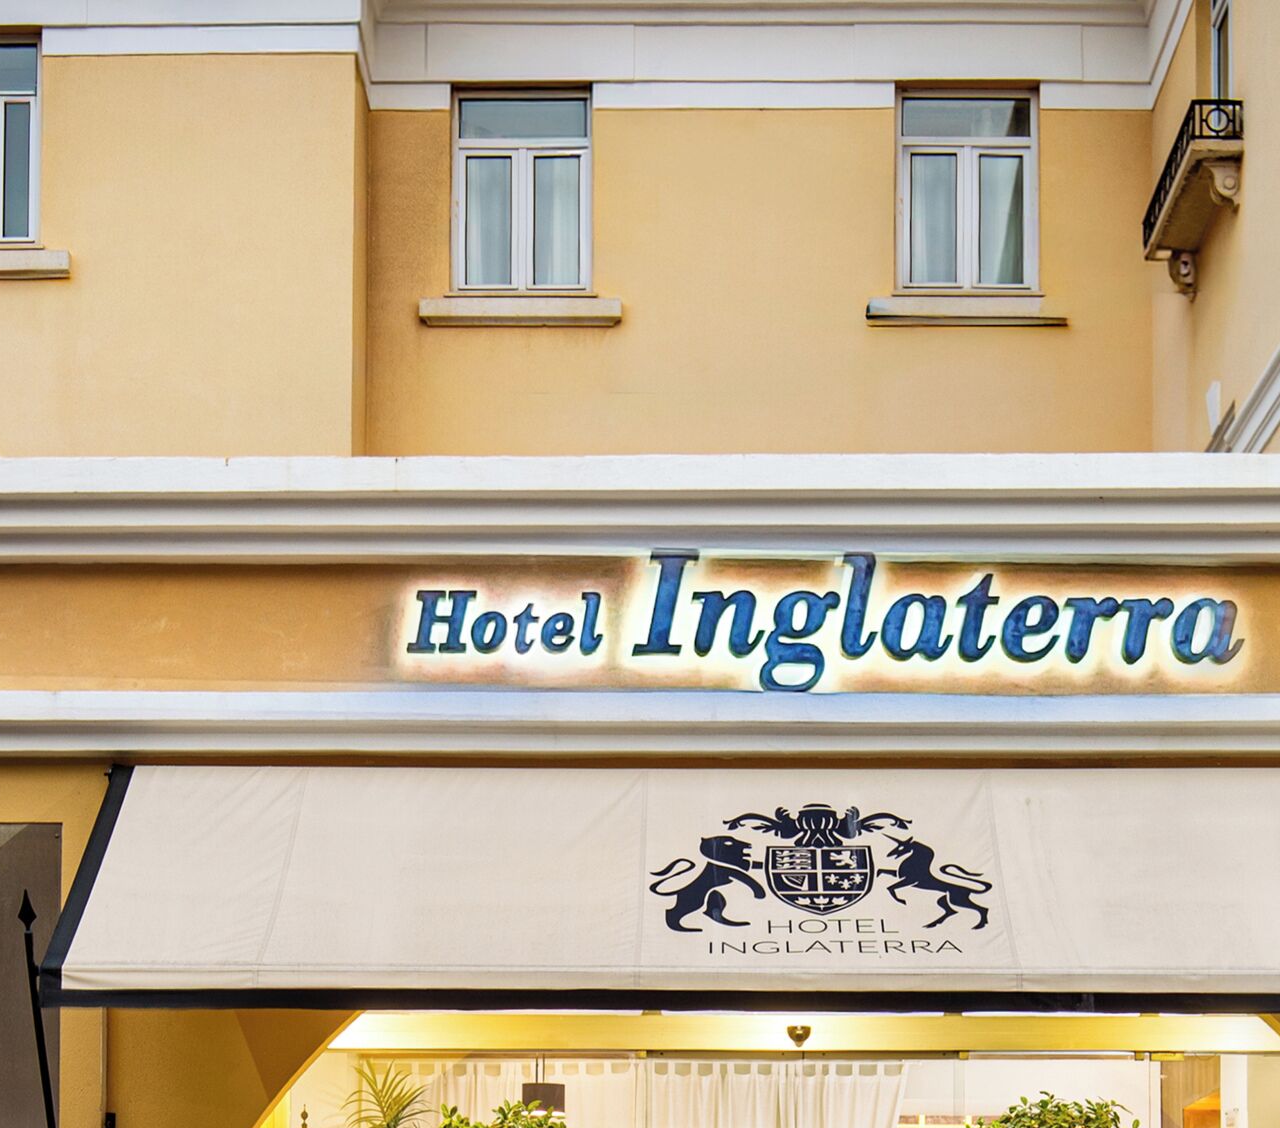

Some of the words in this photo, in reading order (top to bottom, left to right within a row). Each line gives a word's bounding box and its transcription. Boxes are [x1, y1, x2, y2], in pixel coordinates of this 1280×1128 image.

[406, 590, 603, 655] Hotel
[632, 548, 1245, 692] Inglaterra
[767, 918, 900, 935] HOTEL
[708, 939, 964, 955] INGLATERRA
